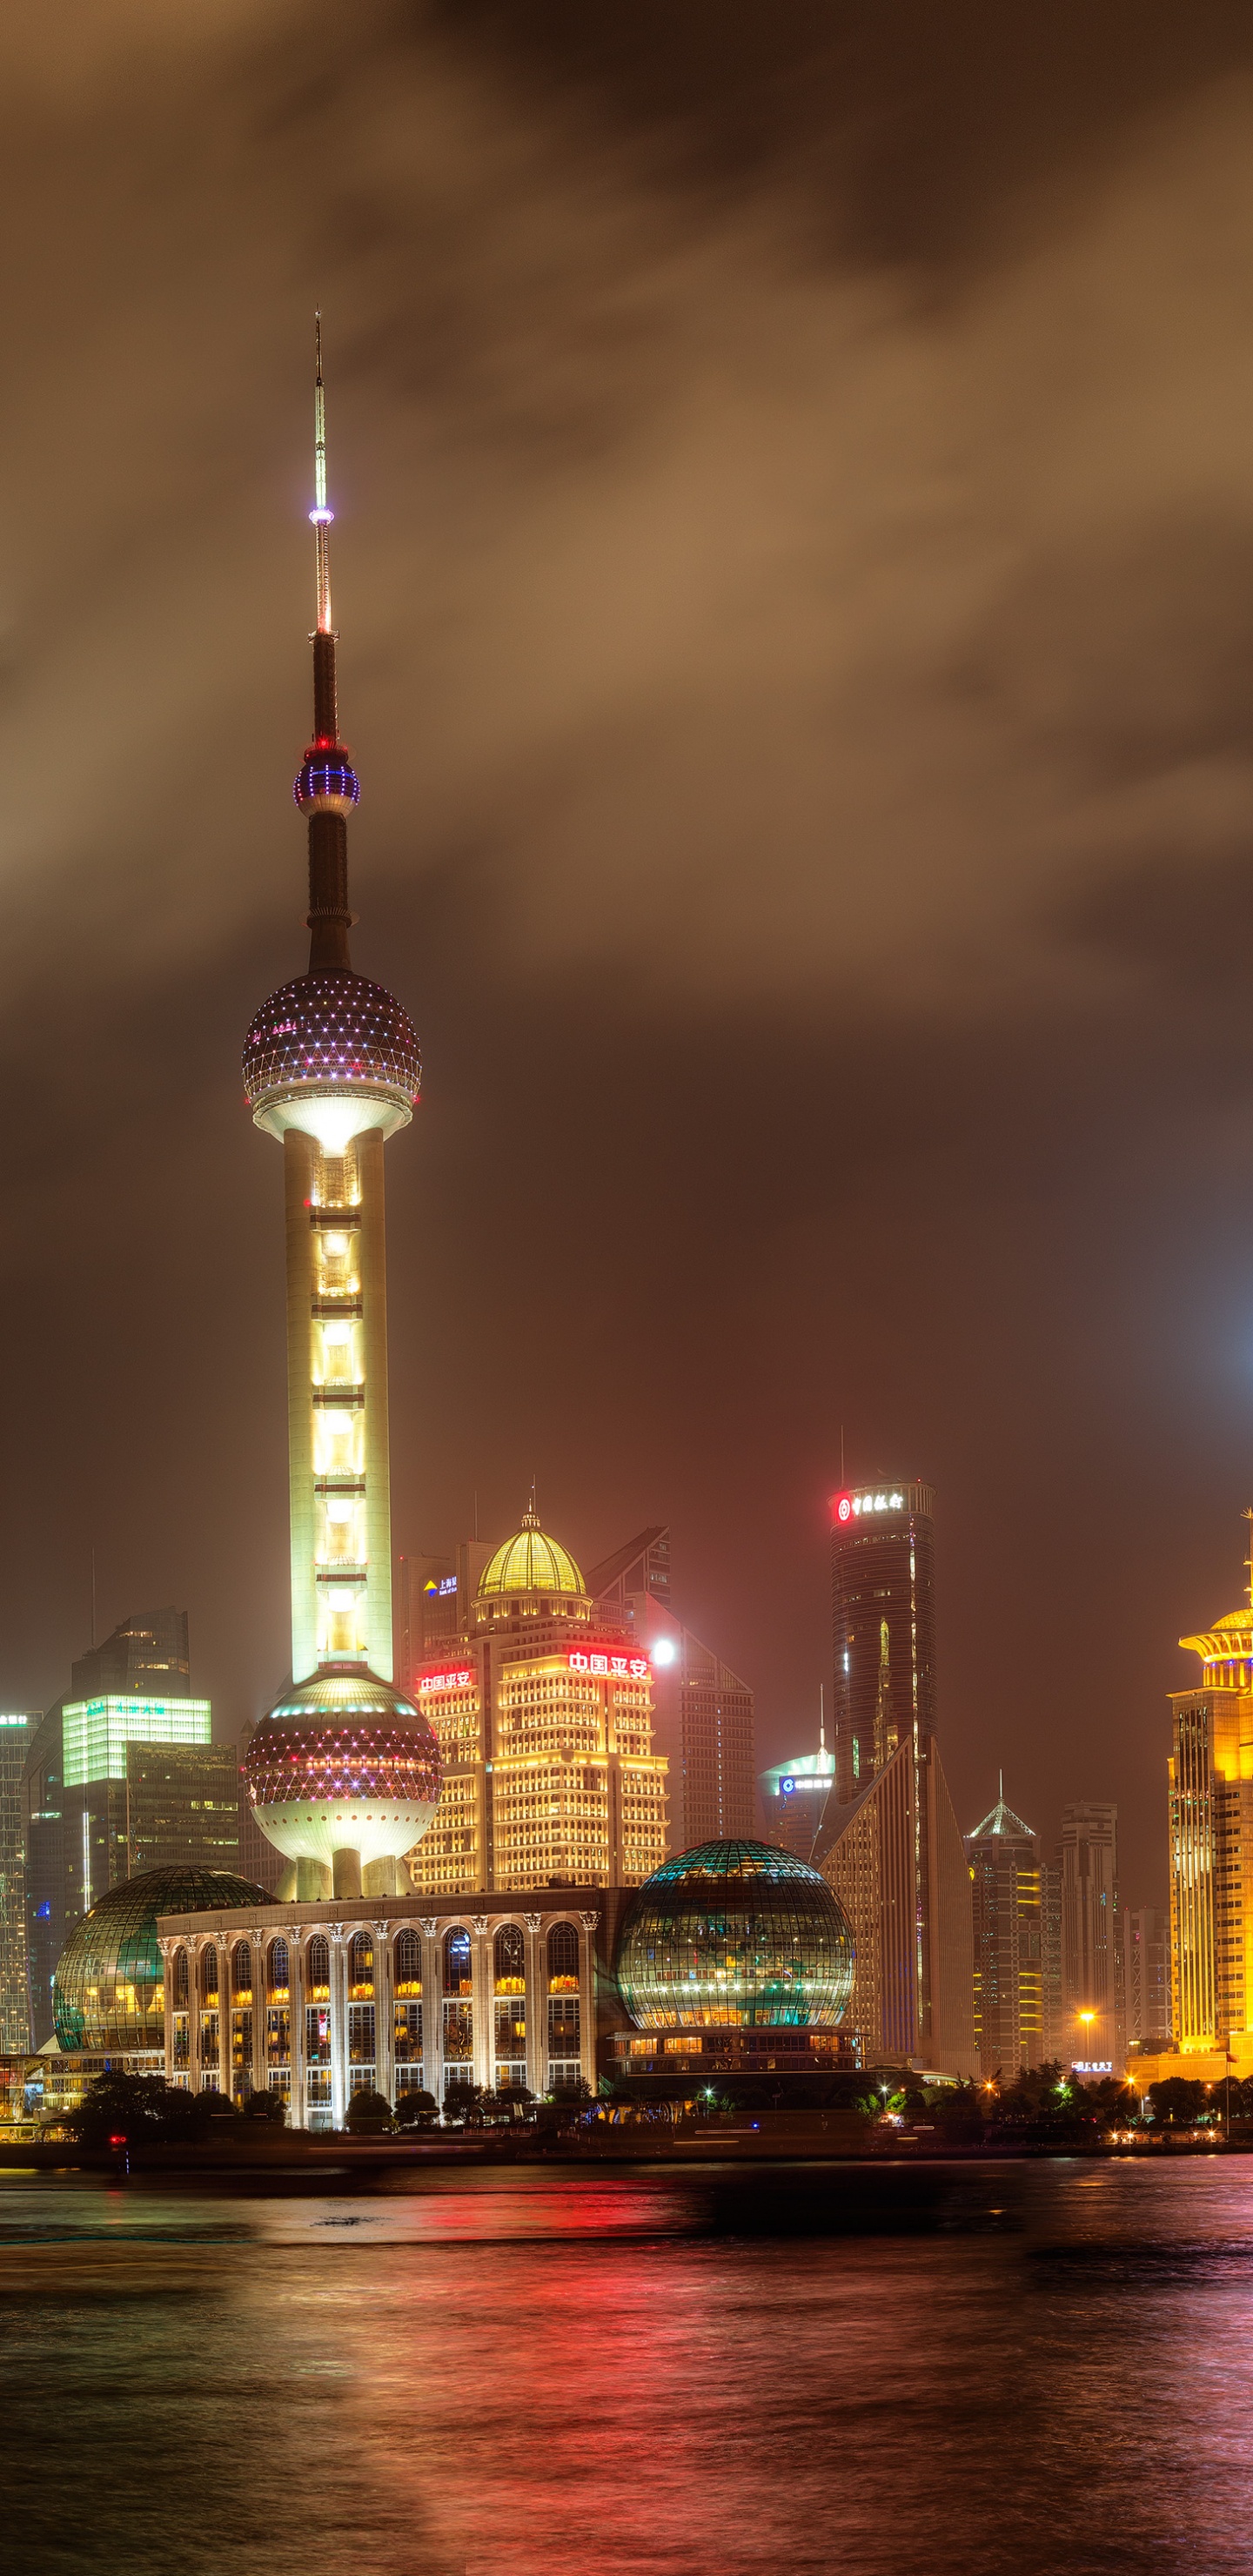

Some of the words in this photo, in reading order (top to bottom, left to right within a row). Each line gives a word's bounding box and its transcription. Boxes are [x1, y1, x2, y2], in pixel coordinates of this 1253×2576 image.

[570, 1652, 647, 1680] 中国平安
[421, 1671, 470, 1693] 中国平安
